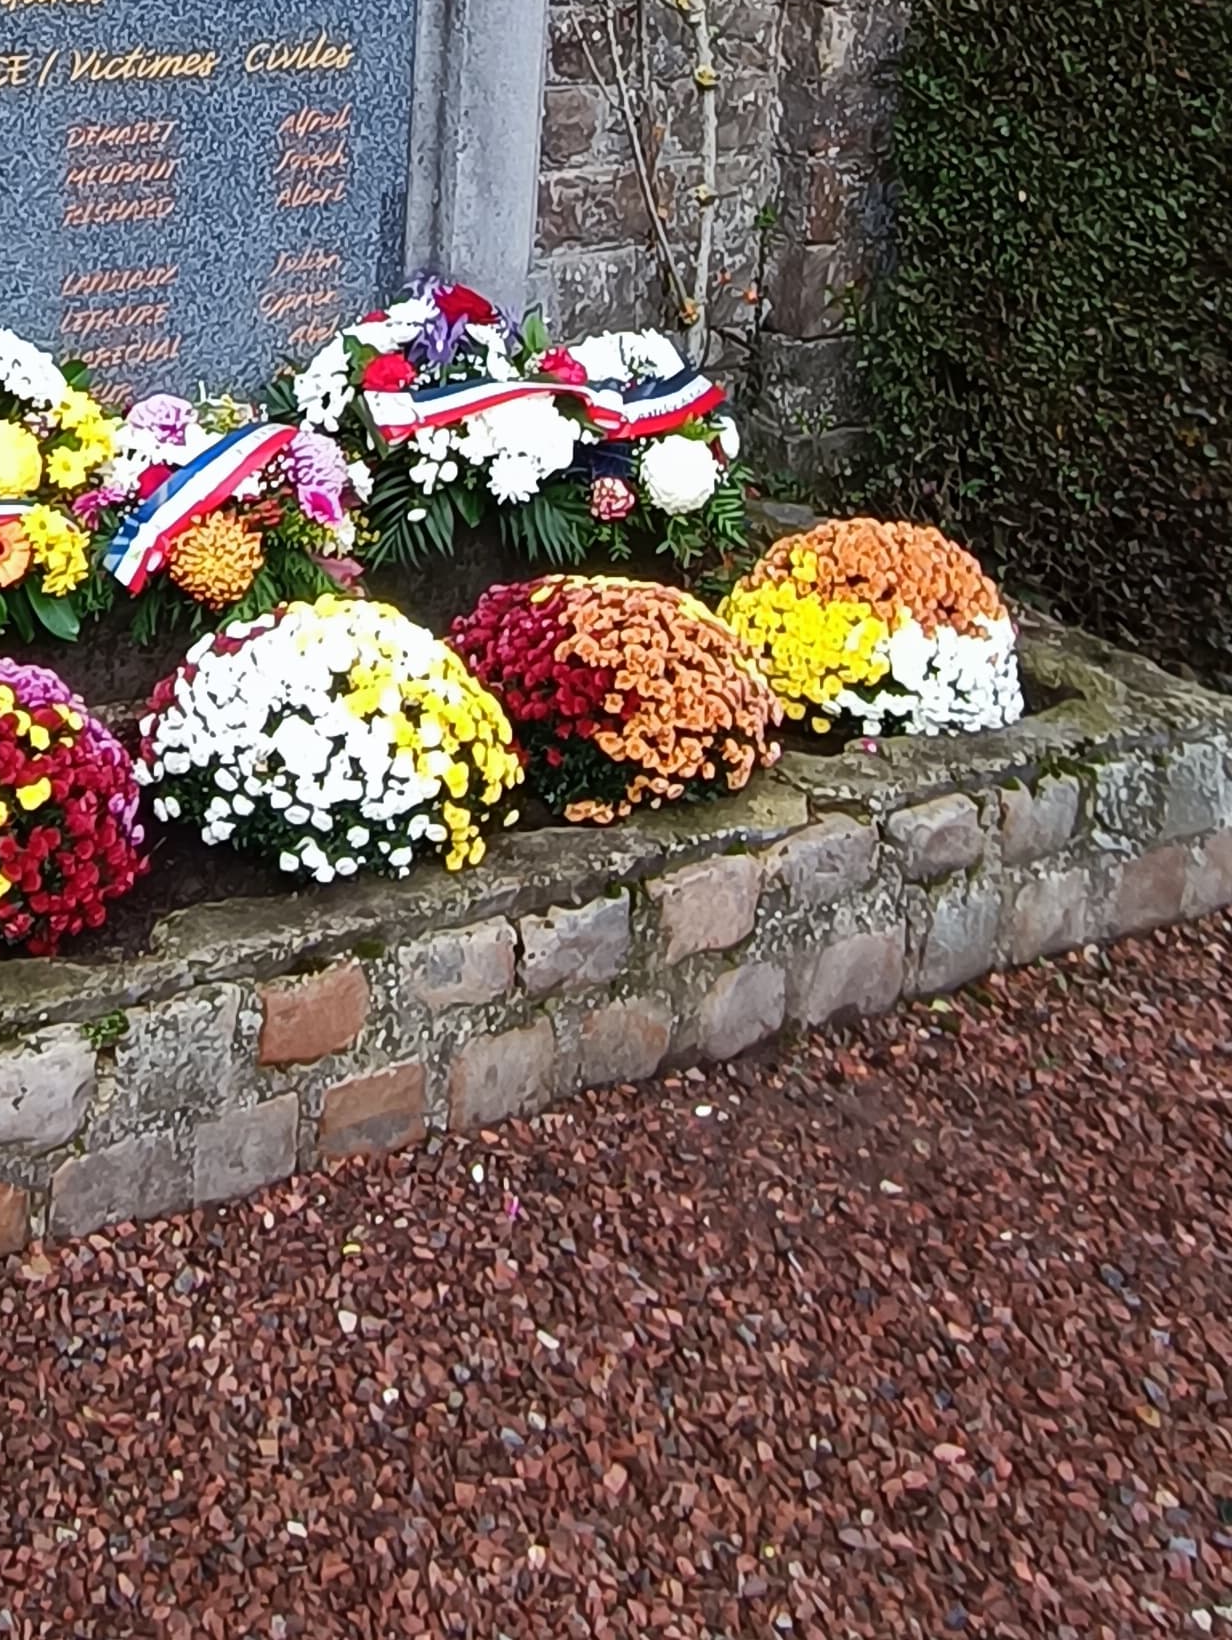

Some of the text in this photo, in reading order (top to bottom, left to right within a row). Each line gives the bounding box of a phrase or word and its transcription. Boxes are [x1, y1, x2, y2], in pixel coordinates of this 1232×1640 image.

[68, 47, 217, 83] Victimes
[244, 29, 355, 73] Civiles
[277, 103, 352, 137] Alfred
[273, 141, 349, 175] Joseph
[277, 184, 346, 209] Albert
[288, 313, 340, 346] Abel
